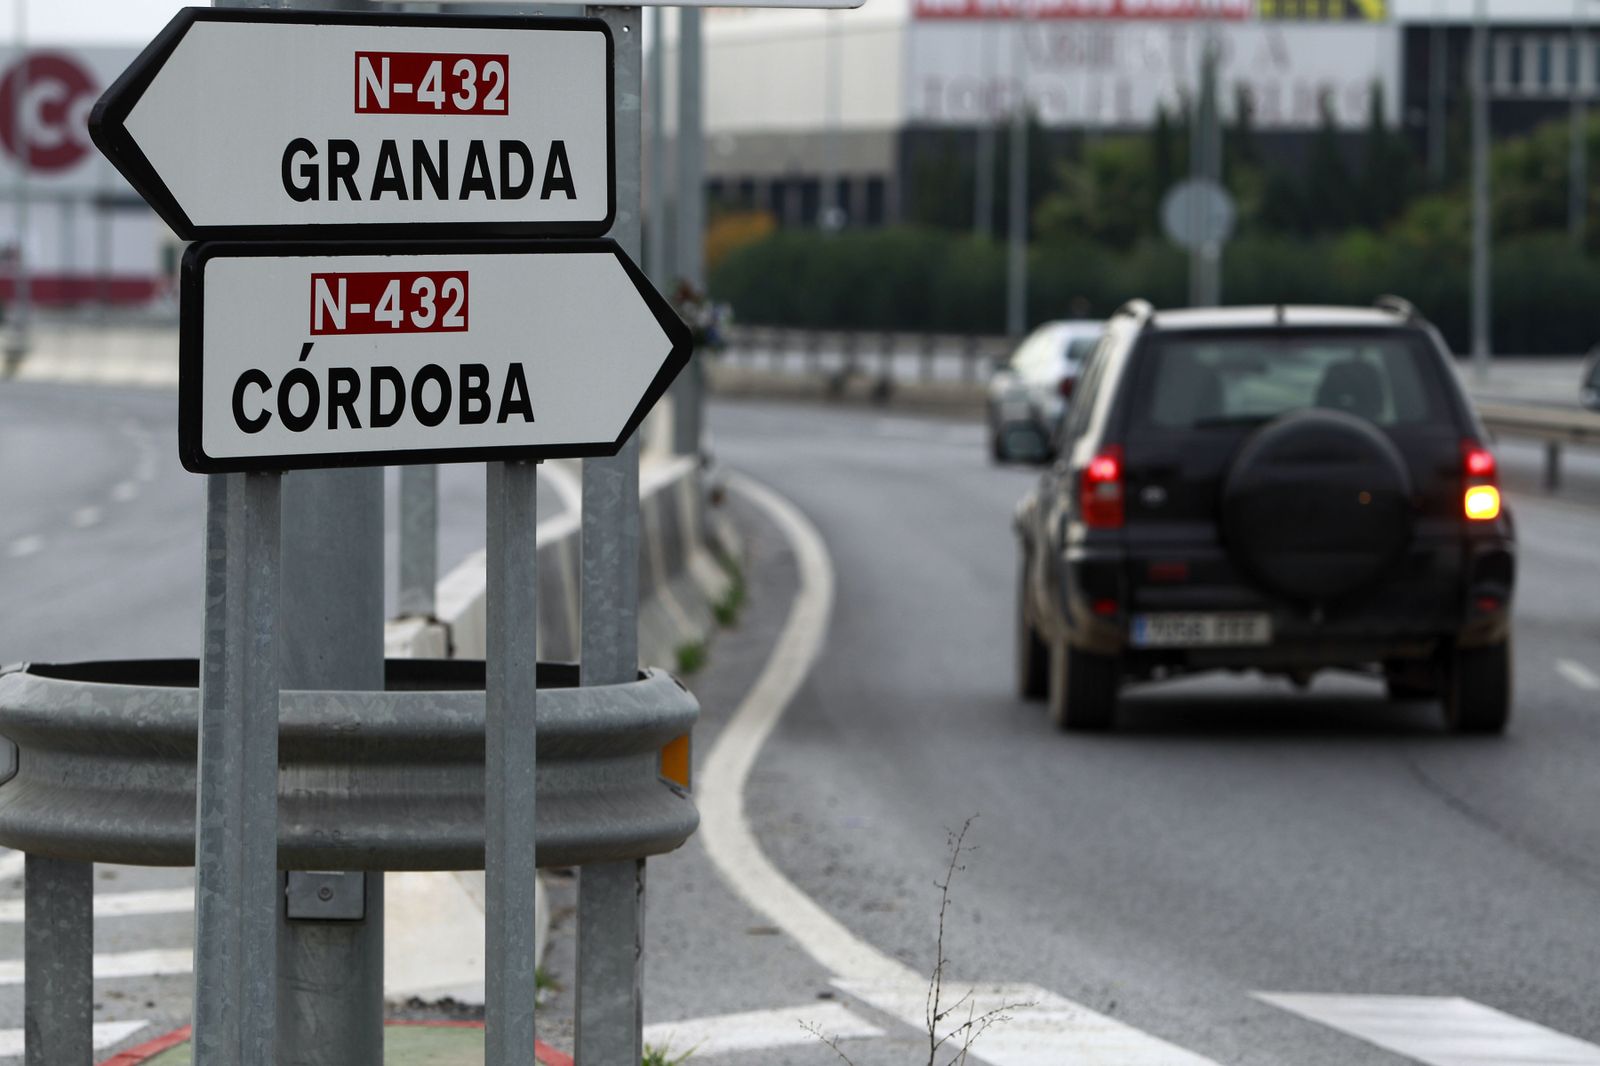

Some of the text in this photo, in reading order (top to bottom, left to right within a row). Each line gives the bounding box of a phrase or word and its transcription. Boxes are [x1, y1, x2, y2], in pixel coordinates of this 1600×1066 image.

[358, 56, 505, 111] N-432
[281, 137, 577, 202] GRANADA
[314, 276, 465, 330] N-432
[231, 342, 535, 434] CÓRDOBA
